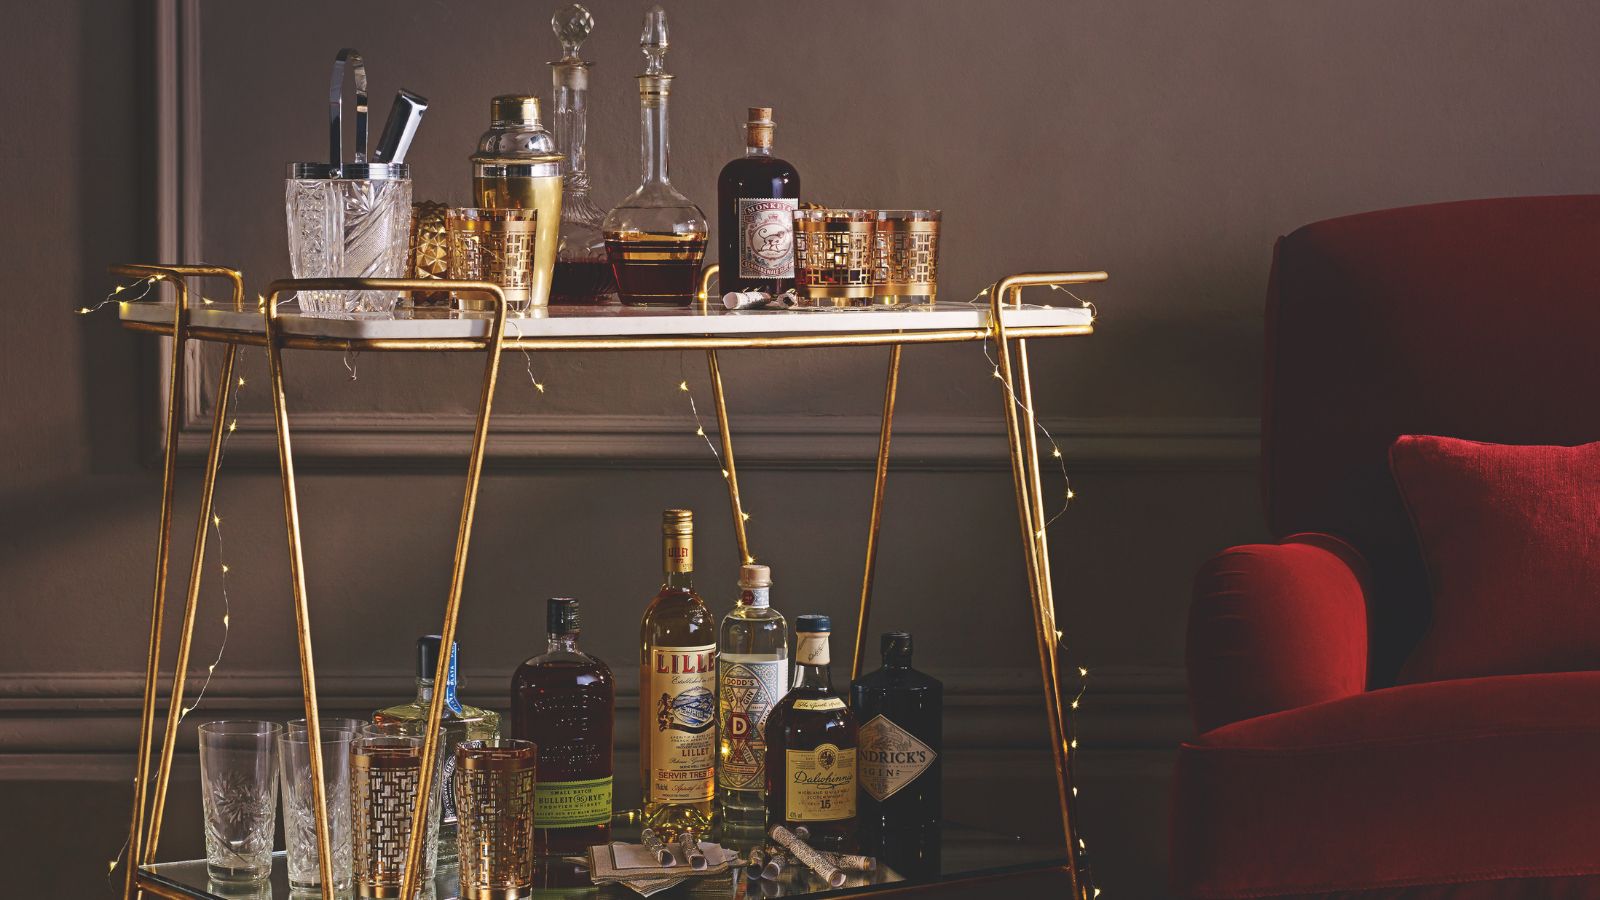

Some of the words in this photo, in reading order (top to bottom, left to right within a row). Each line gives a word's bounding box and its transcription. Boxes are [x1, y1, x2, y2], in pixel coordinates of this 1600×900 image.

[743, 691, 754, 705] GIN
[733, 717, 747, 735] D
[682, 747, 710, 757] LILLET
[658, 771, 687, 779] SERVIR
[538, 796, 573, 804] BULLEIT
[820, 800, 831, 809] 15
